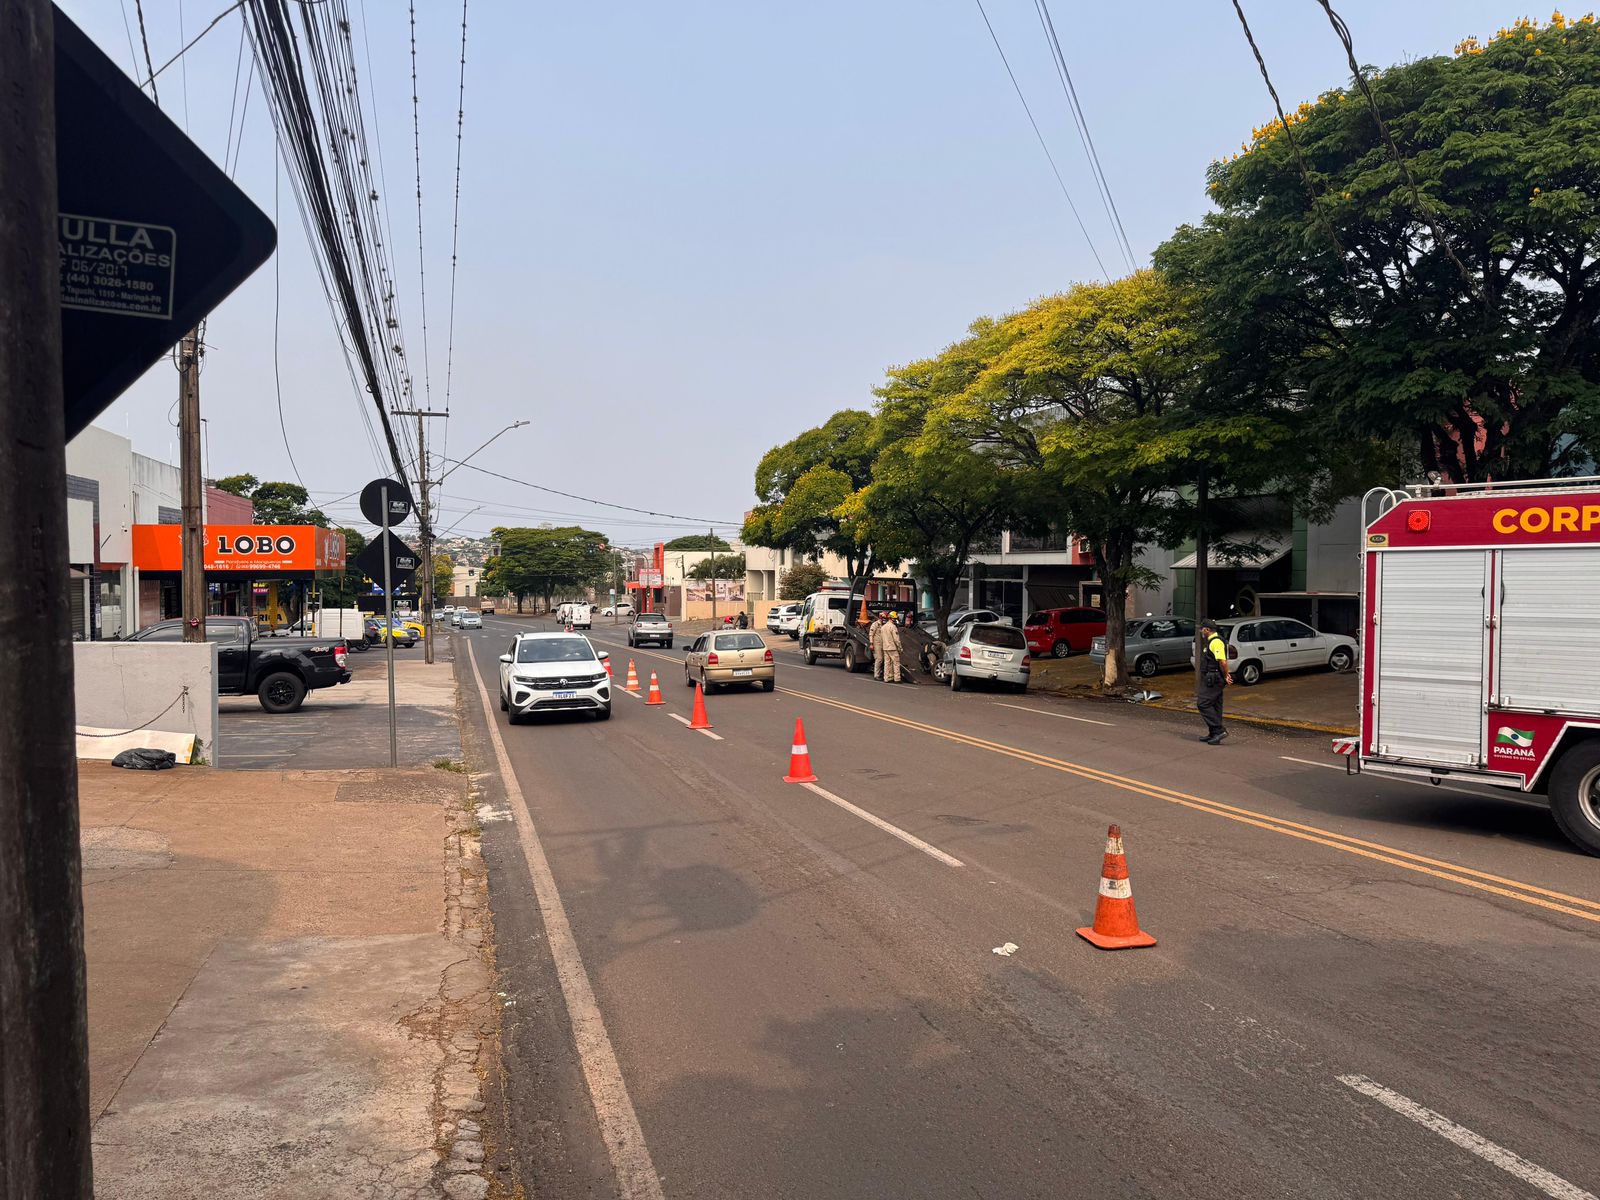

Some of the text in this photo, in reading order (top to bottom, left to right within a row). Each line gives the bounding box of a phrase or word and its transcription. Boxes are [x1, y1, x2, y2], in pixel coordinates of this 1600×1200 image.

[93, 275, 154, 291] 3026-1580
[217, 535, 296, 554] LOBO
[1493, 746, 1535, 758] PARANÁ
